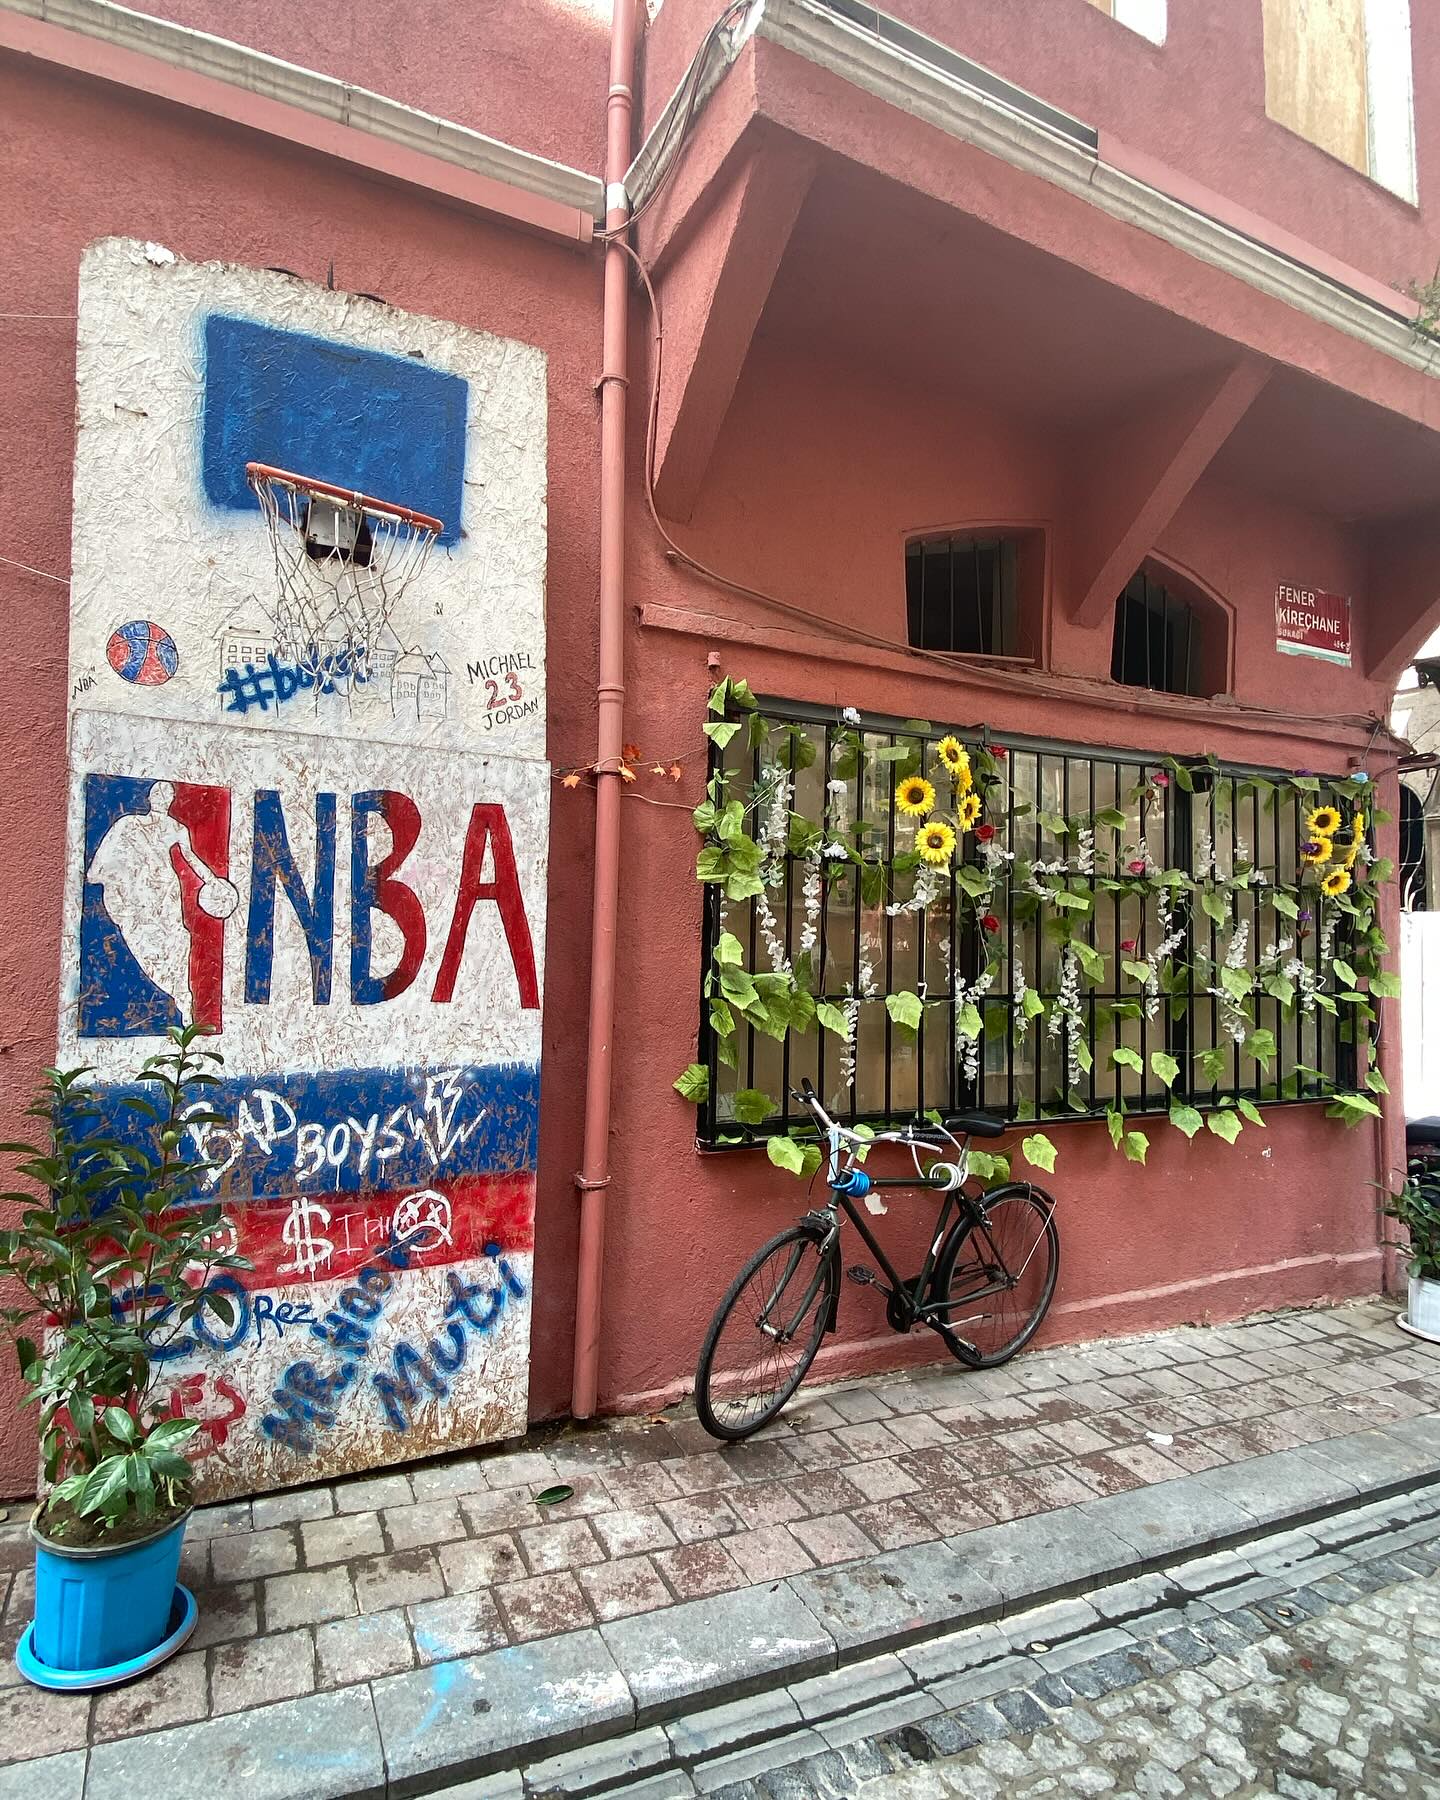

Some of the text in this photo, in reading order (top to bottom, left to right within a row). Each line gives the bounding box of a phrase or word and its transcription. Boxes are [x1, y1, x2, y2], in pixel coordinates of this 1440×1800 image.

[1279, 585, 1315, 608] FENER
[1279, 606, 1341, 635] KİREÇHANE
[467, 652, 536, 684] MICHAEL
[485, 671, 522, 710] 23
[482, 697, 538, 731] JORDAN
[244, 788, 541, 1009] NBA
[177, 1088, 297, 1192] BAD
[295, 1105, 407, 1182] BOYS
